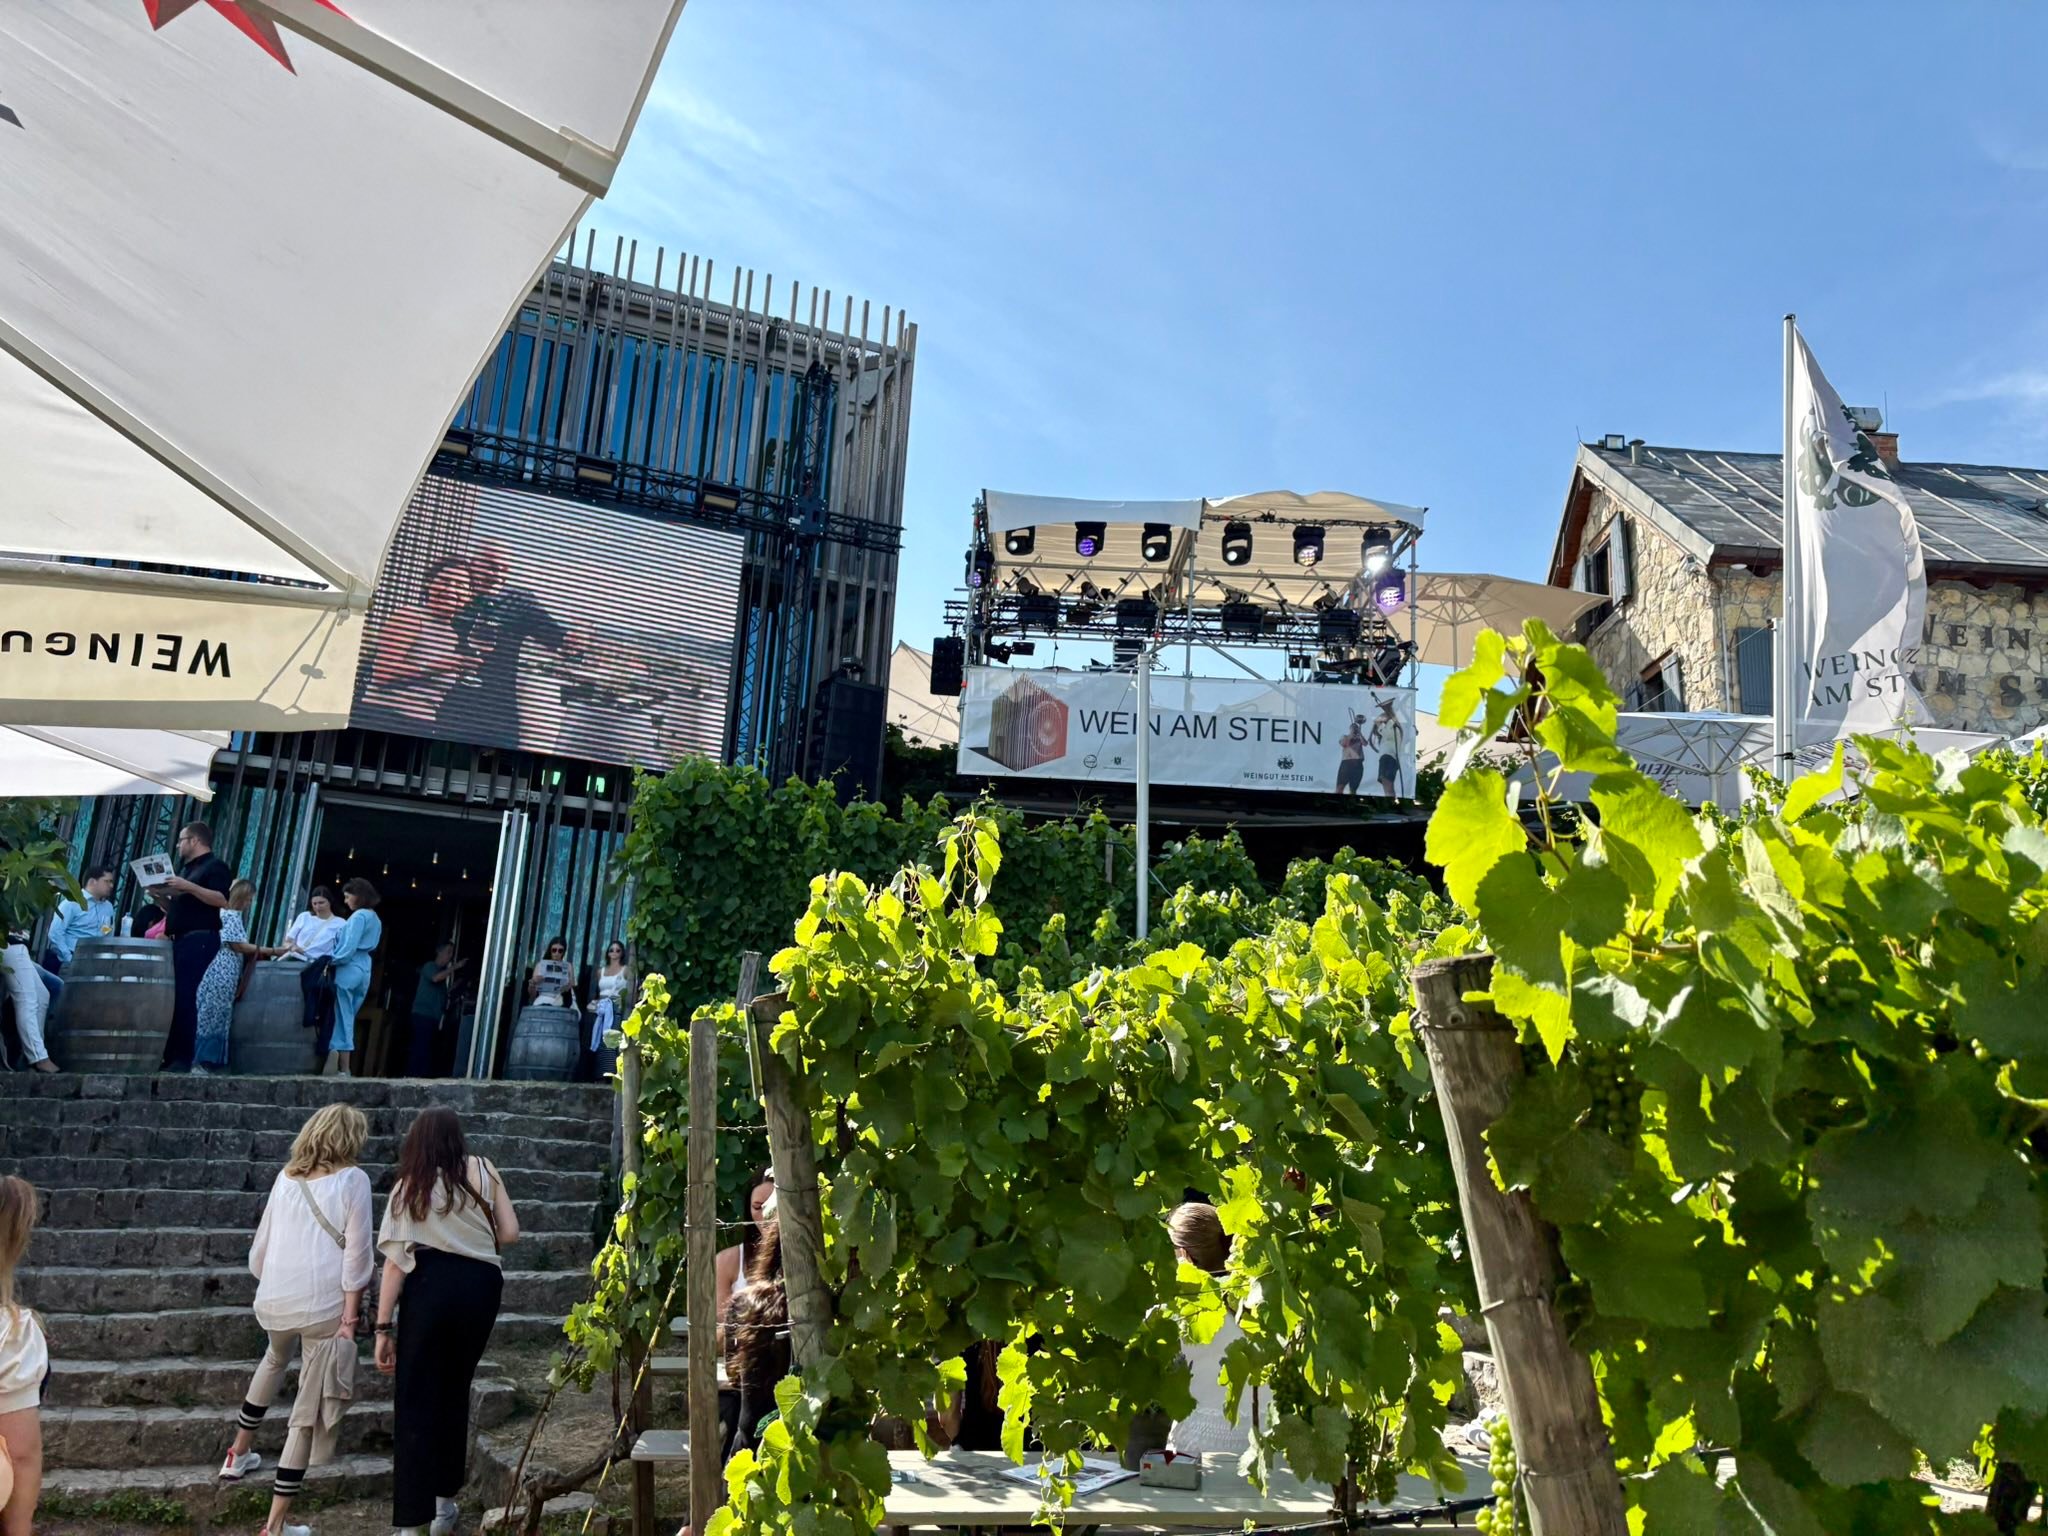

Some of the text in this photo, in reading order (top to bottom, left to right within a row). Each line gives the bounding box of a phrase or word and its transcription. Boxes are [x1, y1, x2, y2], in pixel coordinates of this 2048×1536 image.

[1, 630, 231, 678] WEINGU
[1079, 709, 1322, 744] WEIN AM STEIN
[1243, 772, 1279, 780] WEINGUT
[1291, 774, 1314, 782] STEIN
